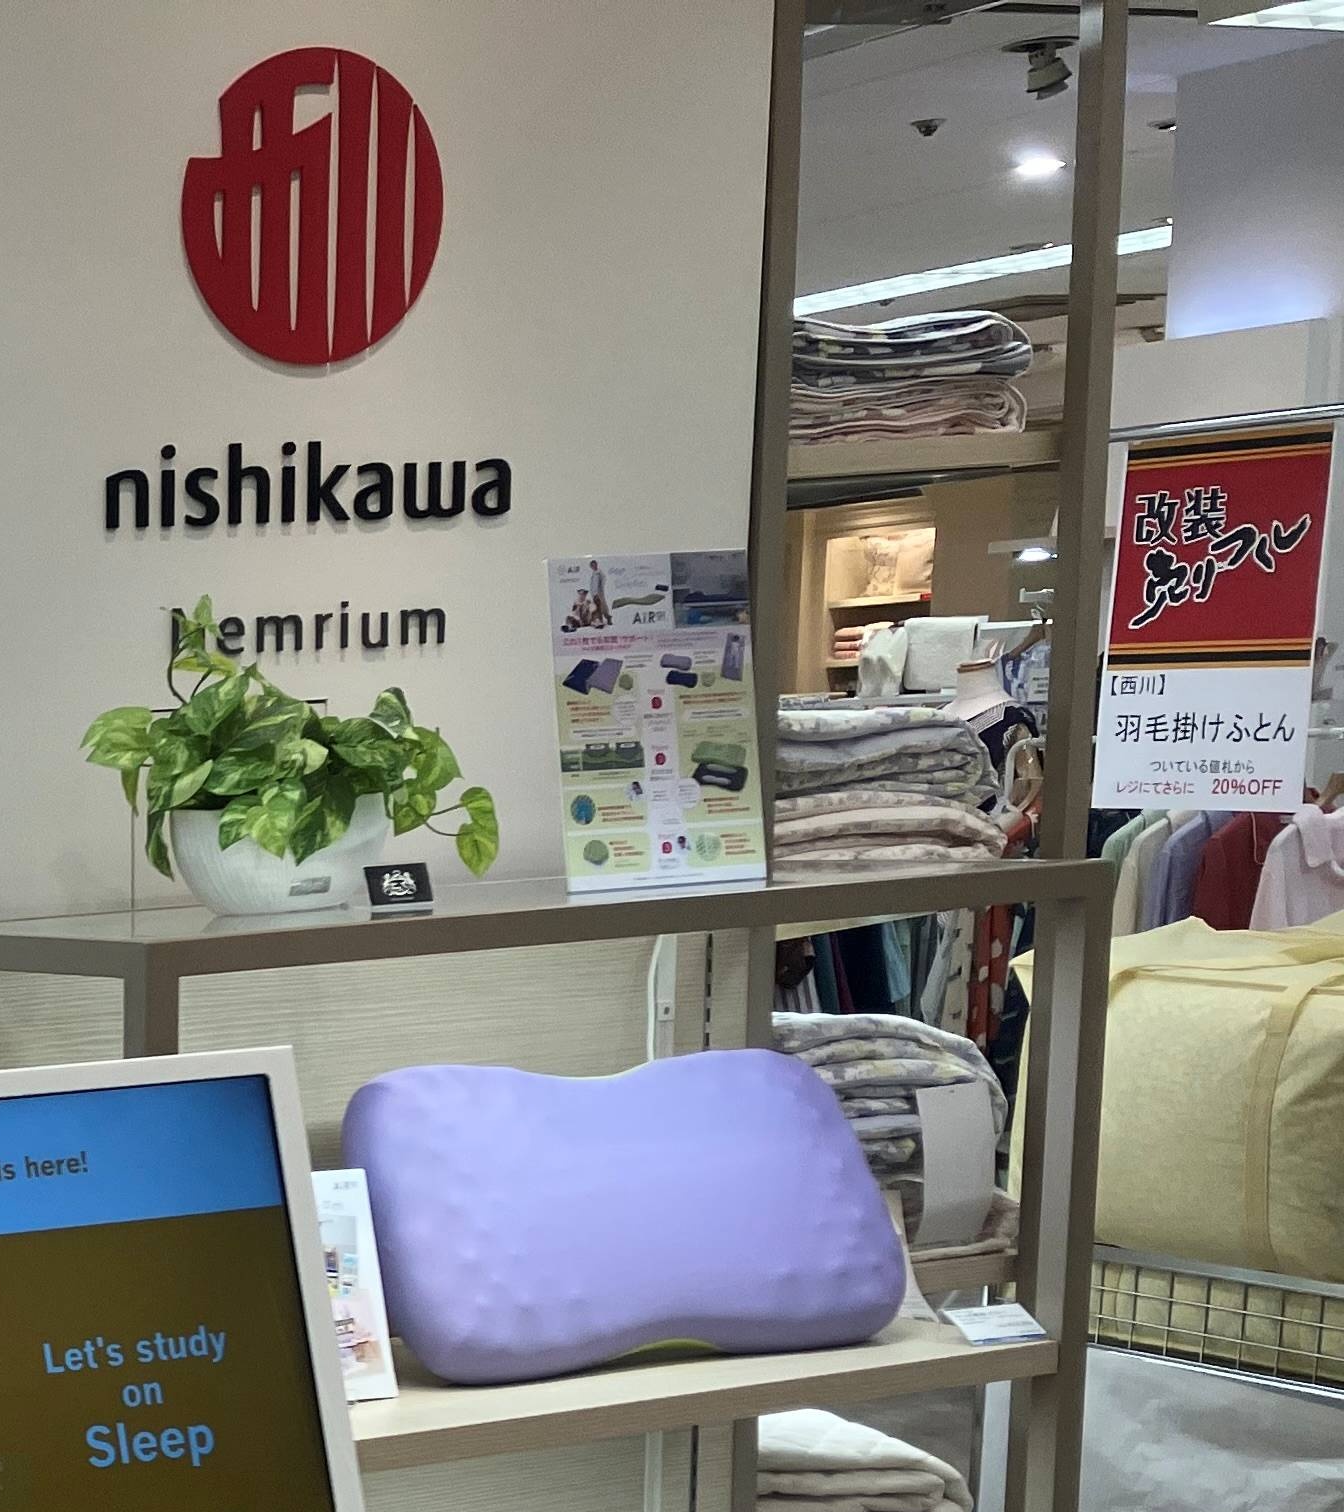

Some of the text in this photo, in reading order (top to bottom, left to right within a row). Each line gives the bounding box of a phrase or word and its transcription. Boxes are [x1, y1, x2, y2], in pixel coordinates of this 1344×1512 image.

[105, 440, 512, 529] nishikawa
[1134, 484, 1228, 546] 改装
[1109, 672, 1168, 696] 【西川】
[1114, 712, 1296, 744] 羽毛掛けふとん
[1150, 758, 1256, 775] ついている値札から
[1211, 777, 1284, 796] 20%OFF
[24, 1151, 89, 1178] here!
[42, 1325, 228, 1374] Let's study
[122, 1378, 164, 1408] on
[84, 1420, 216, 1468] Sleep
